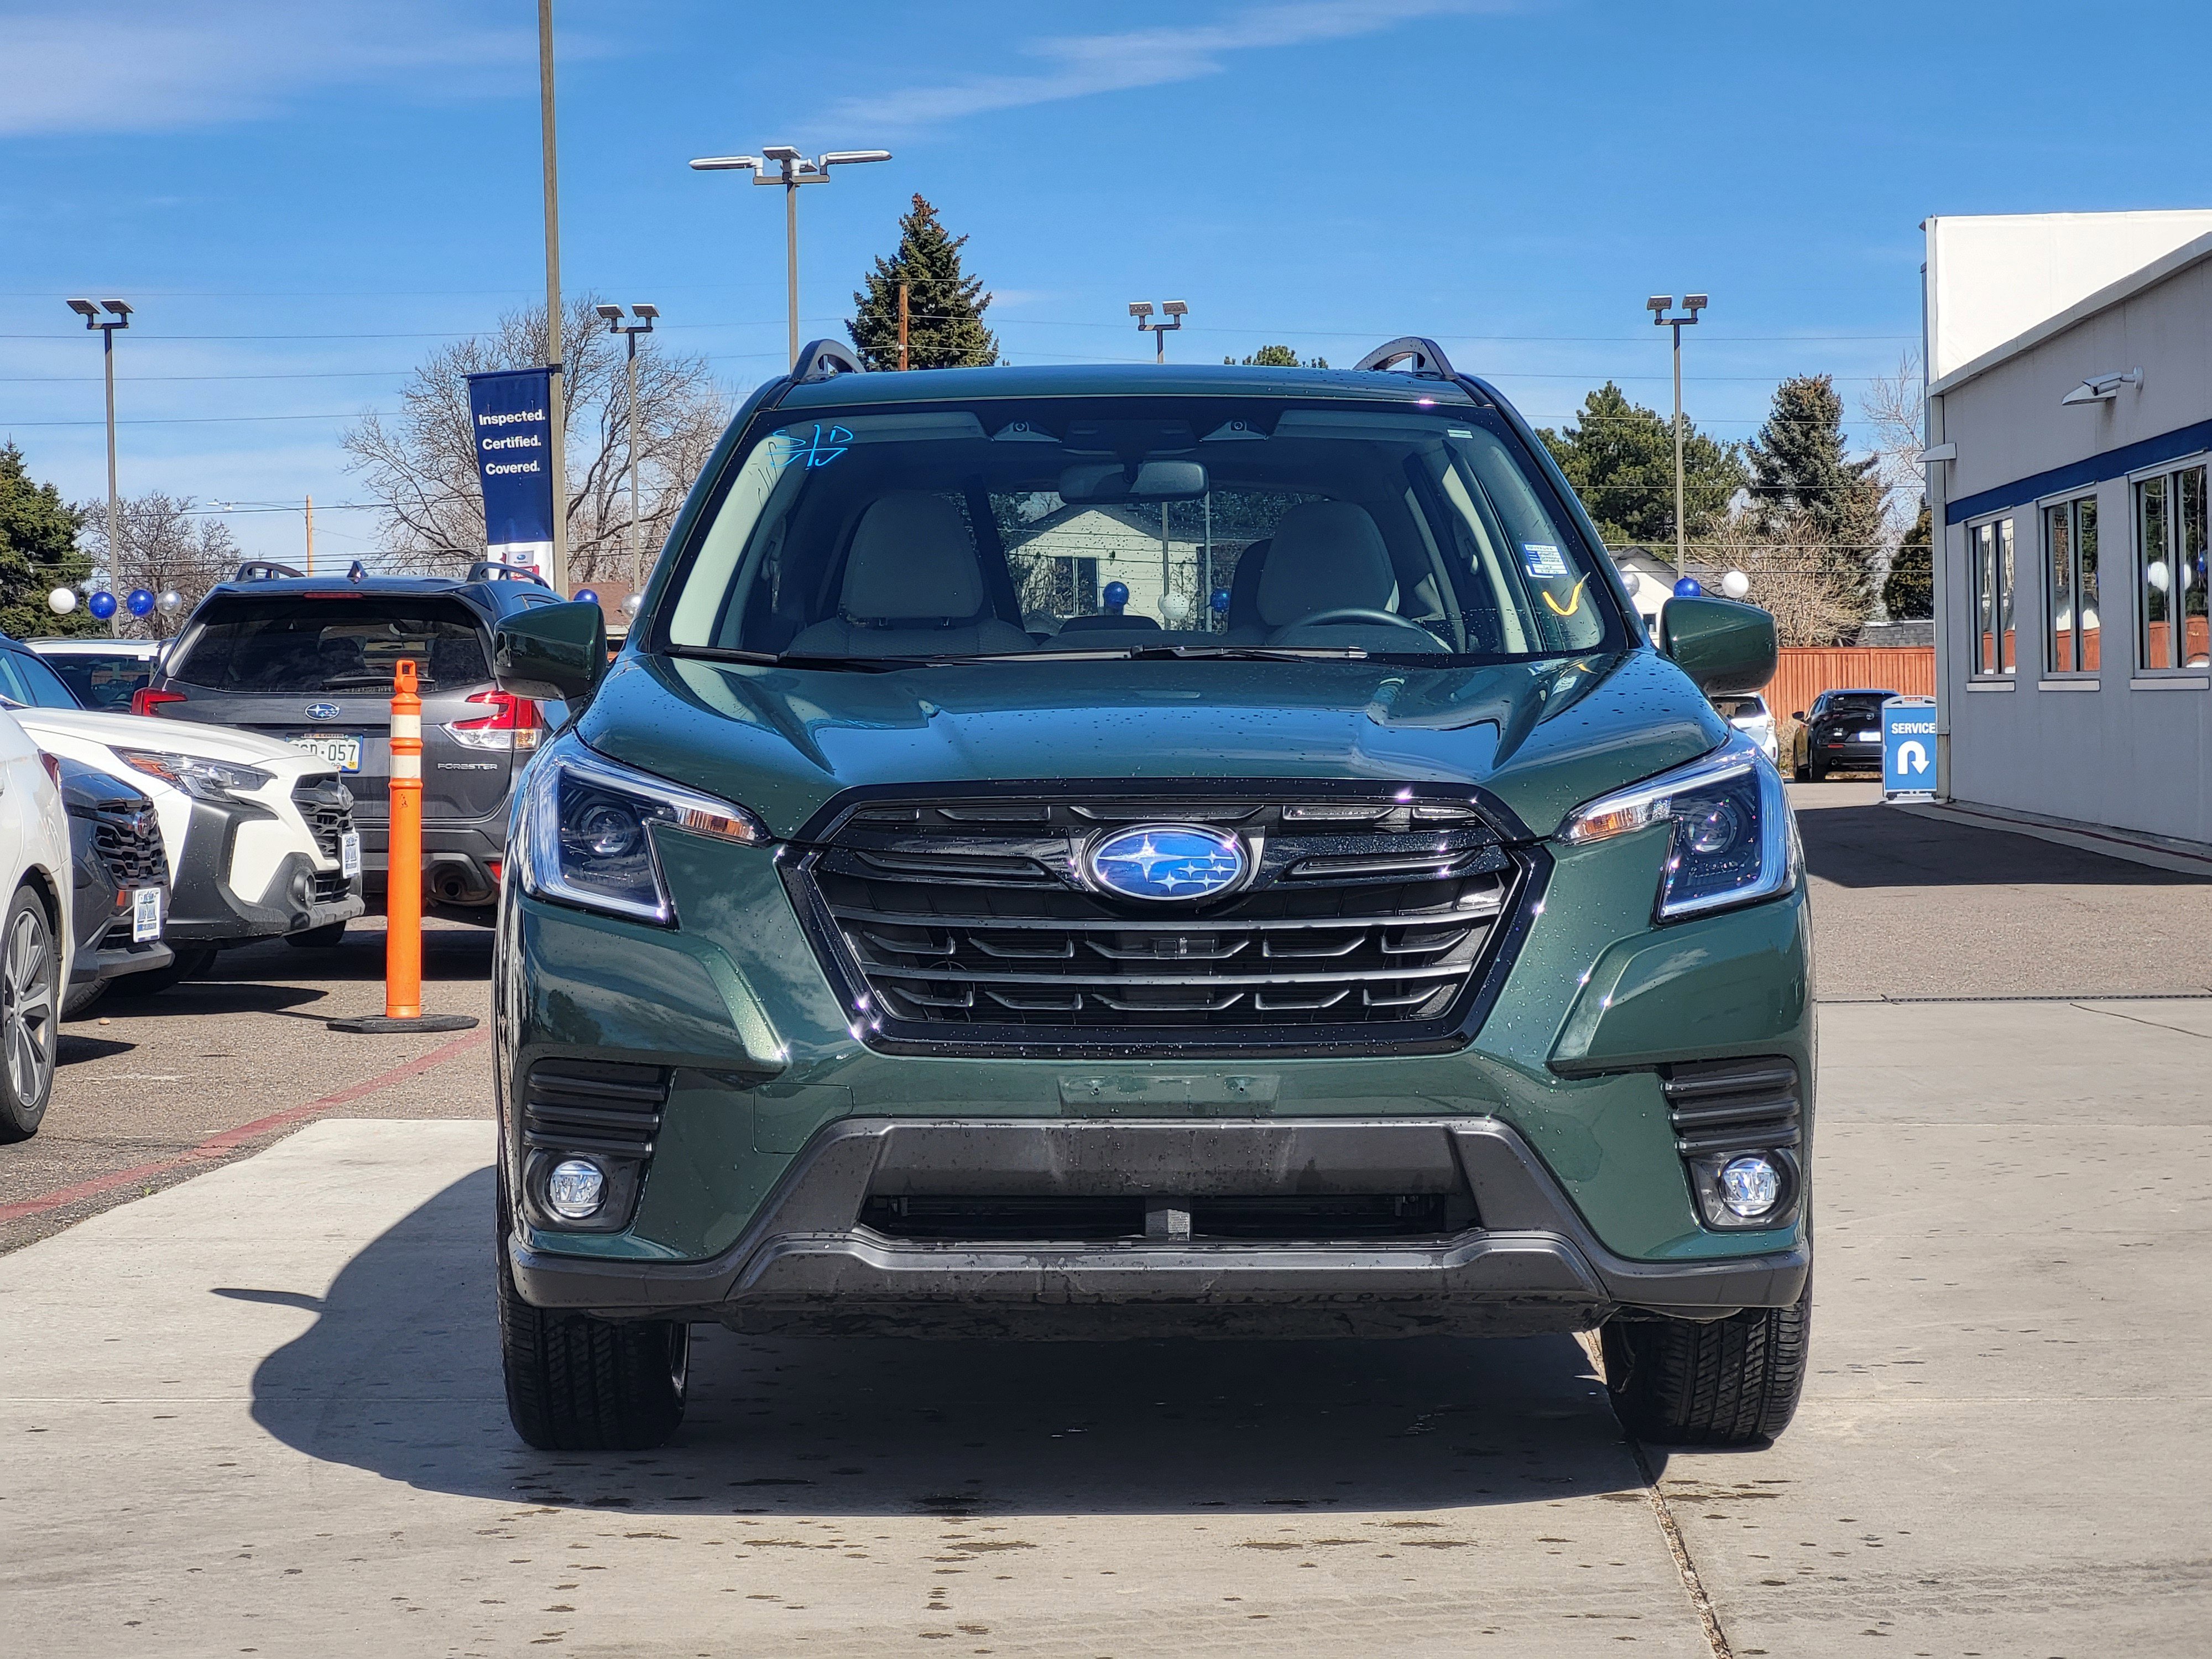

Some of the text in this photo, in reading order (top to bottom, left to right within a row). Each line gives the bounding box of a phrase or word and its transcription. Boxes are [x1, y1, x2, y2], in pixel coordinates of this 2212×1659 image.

[478, 409, 546, 426] Inspected.
[482, 435, 541, 450] Certified.
[486, 460, 540, 475] Covered.
[1891, 723, 1936, 734] SERVICE
